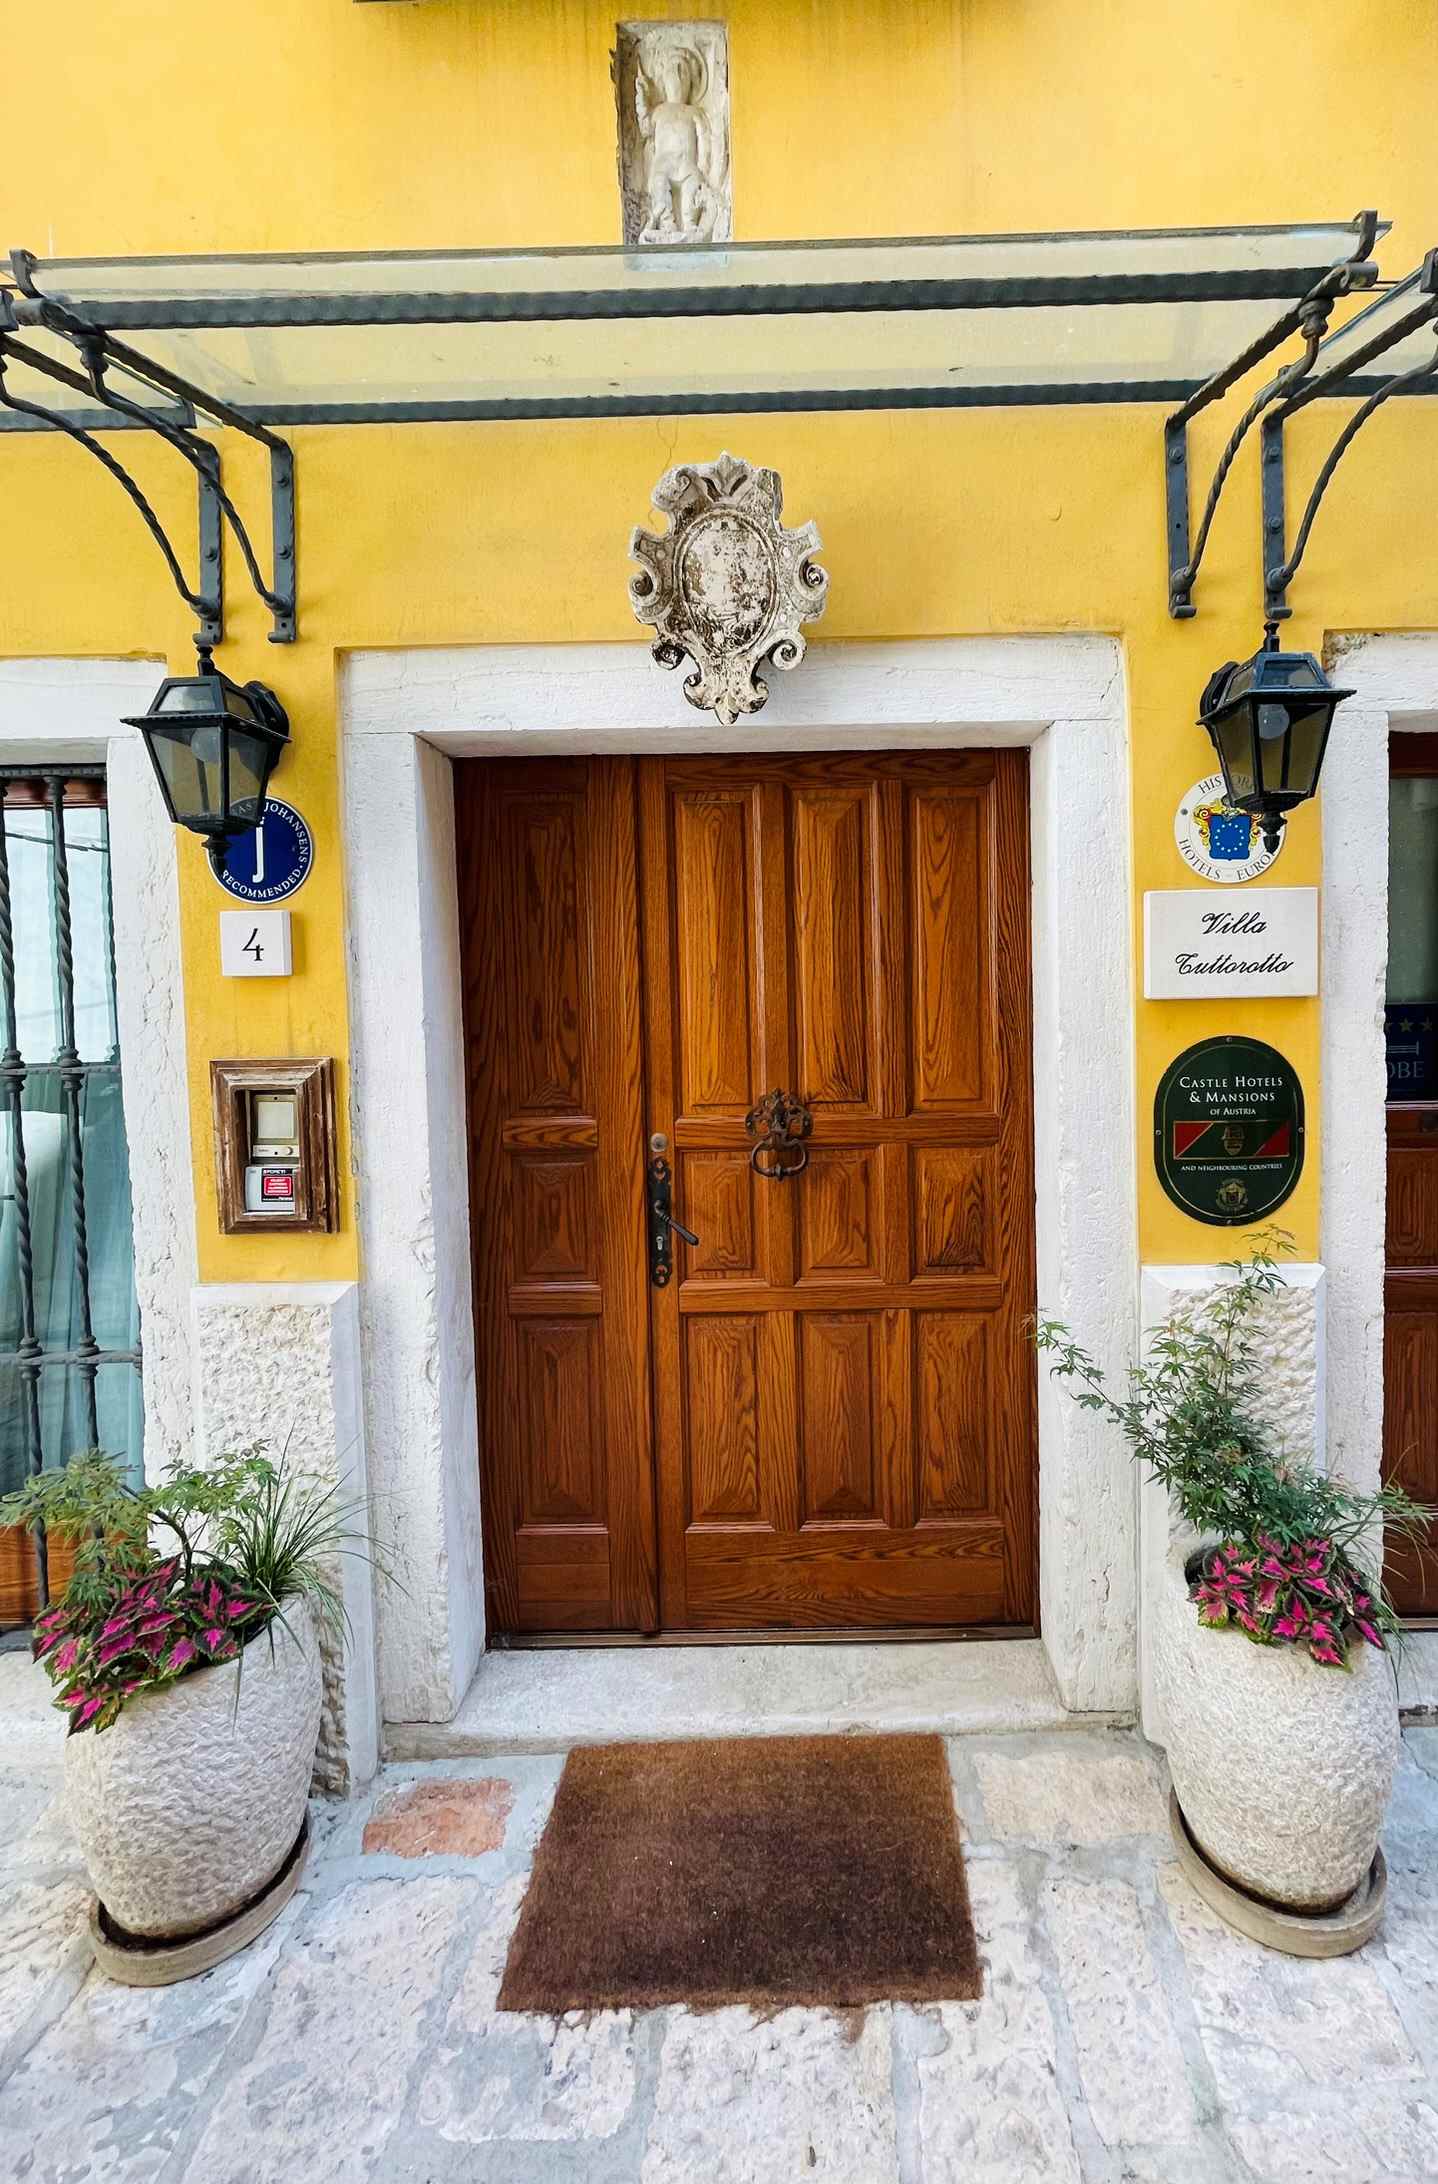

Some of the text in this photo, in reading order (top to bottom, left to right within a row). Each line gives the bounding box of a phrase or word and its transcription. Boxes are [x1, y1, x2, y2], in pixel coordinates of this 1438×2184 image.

[264, 802, 308, 863] JOHANSENS
[1180, 838, 1275, 881] HOTELS EURO
[222, 869, 301, 898] RECOMMENDED
[1202, 912, 1267, 934] Villa
[242, 927, 265, 962] 4
[1175, 953, 1295, 975] Tuttorotto
[1179, 1075, 1283, 1089] CASTLE HOTELS
[1189, 1091, 1275, 1103] & MANSIONS
[1223, 1107, 1257, 1116] AUSTRIA
